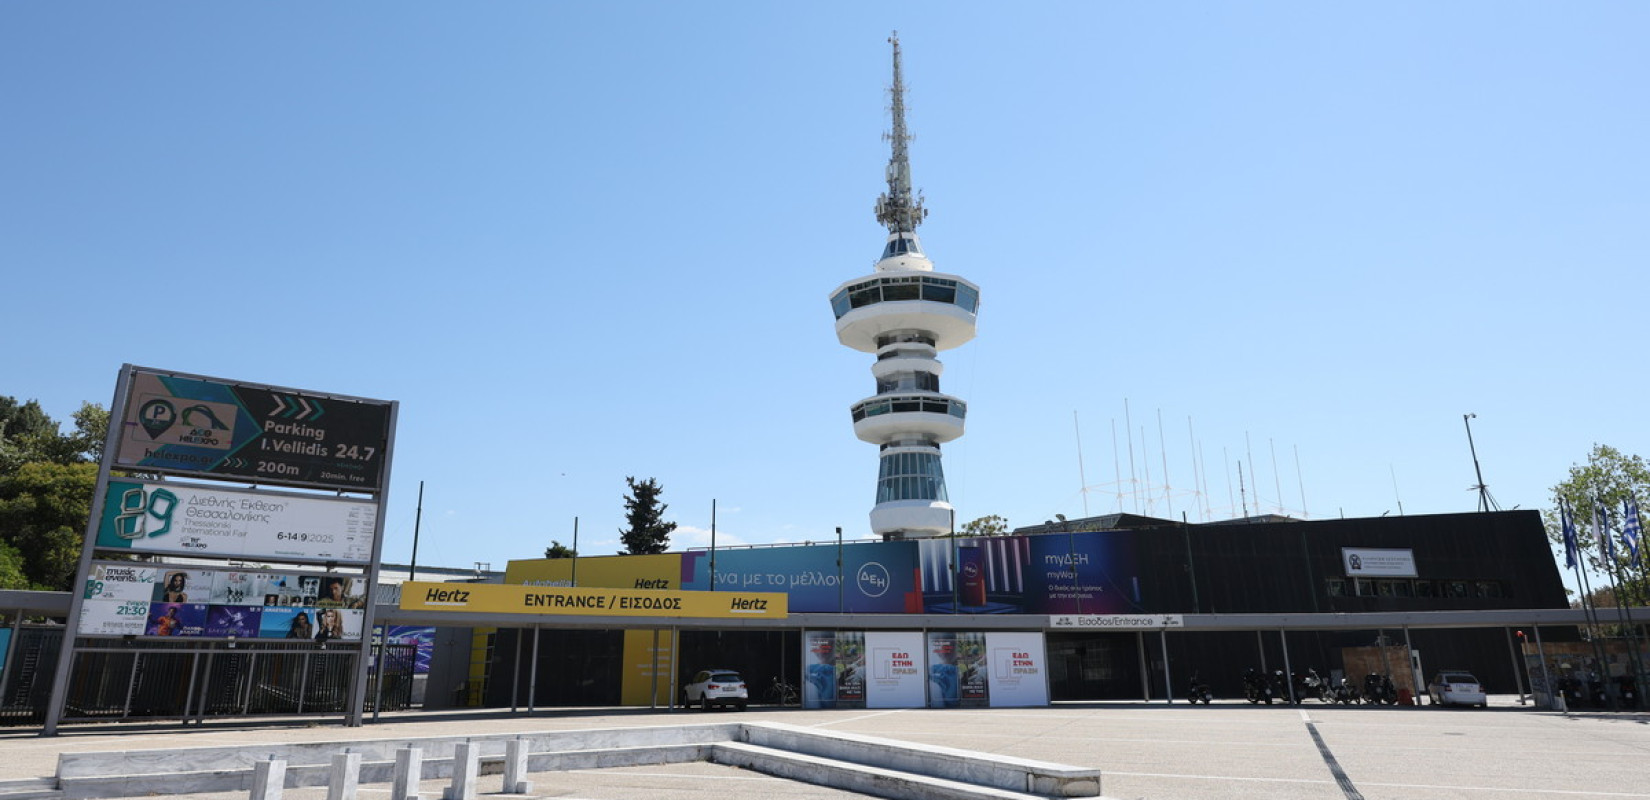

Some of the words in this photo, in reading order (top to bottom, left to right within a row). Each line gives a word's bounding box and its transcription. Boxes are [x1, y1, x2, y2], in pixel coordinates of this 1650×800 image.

[153, 405, 166, 419] P
[264, 420, 326, 441] Parking
[179, 435, 219, 446] HELEXPO
[144, 447, 215, 465] helexpo.gr
[335, 443, 375, 461] 24.7
[256, 461, 300, 475] 200m
[348, 473, 366, 482] free
[188, 494, 236, 510] Διεθνής
[114, 487, 179, 540] 89
[186, 506, 270, 524] Θεσσαλονίκης
[184, 518, 232, 529] Thessaloniki
[181, 527, 232, 538] International
[232, 529, 249, 538] Fair
[105, 575, 137, 583] events
[106, 568, 136, 577] music
[743, 573, 762, 588] με
[766, 573, 786, 585] το
[790, 571, 845, 588] μέλλον
[860, 571, 885, 588] ΔΕΗ
[634, 578, 669, 589] Hertz
[425, 588, 470, 603] Hertz
[524, 593, 606, 609] ENTRANCE
[608, 595, 617, 610] /
[619, 597, 682, 610] ΕΙΣΟΔΟΣ
[116, 605, 147, 616] 21:30
[731, 597, 768, 610] Hertz
[892, 652, 909, 660] ΕΔΩ
[1012, 652, 1029, 660] ΕΔΩ
